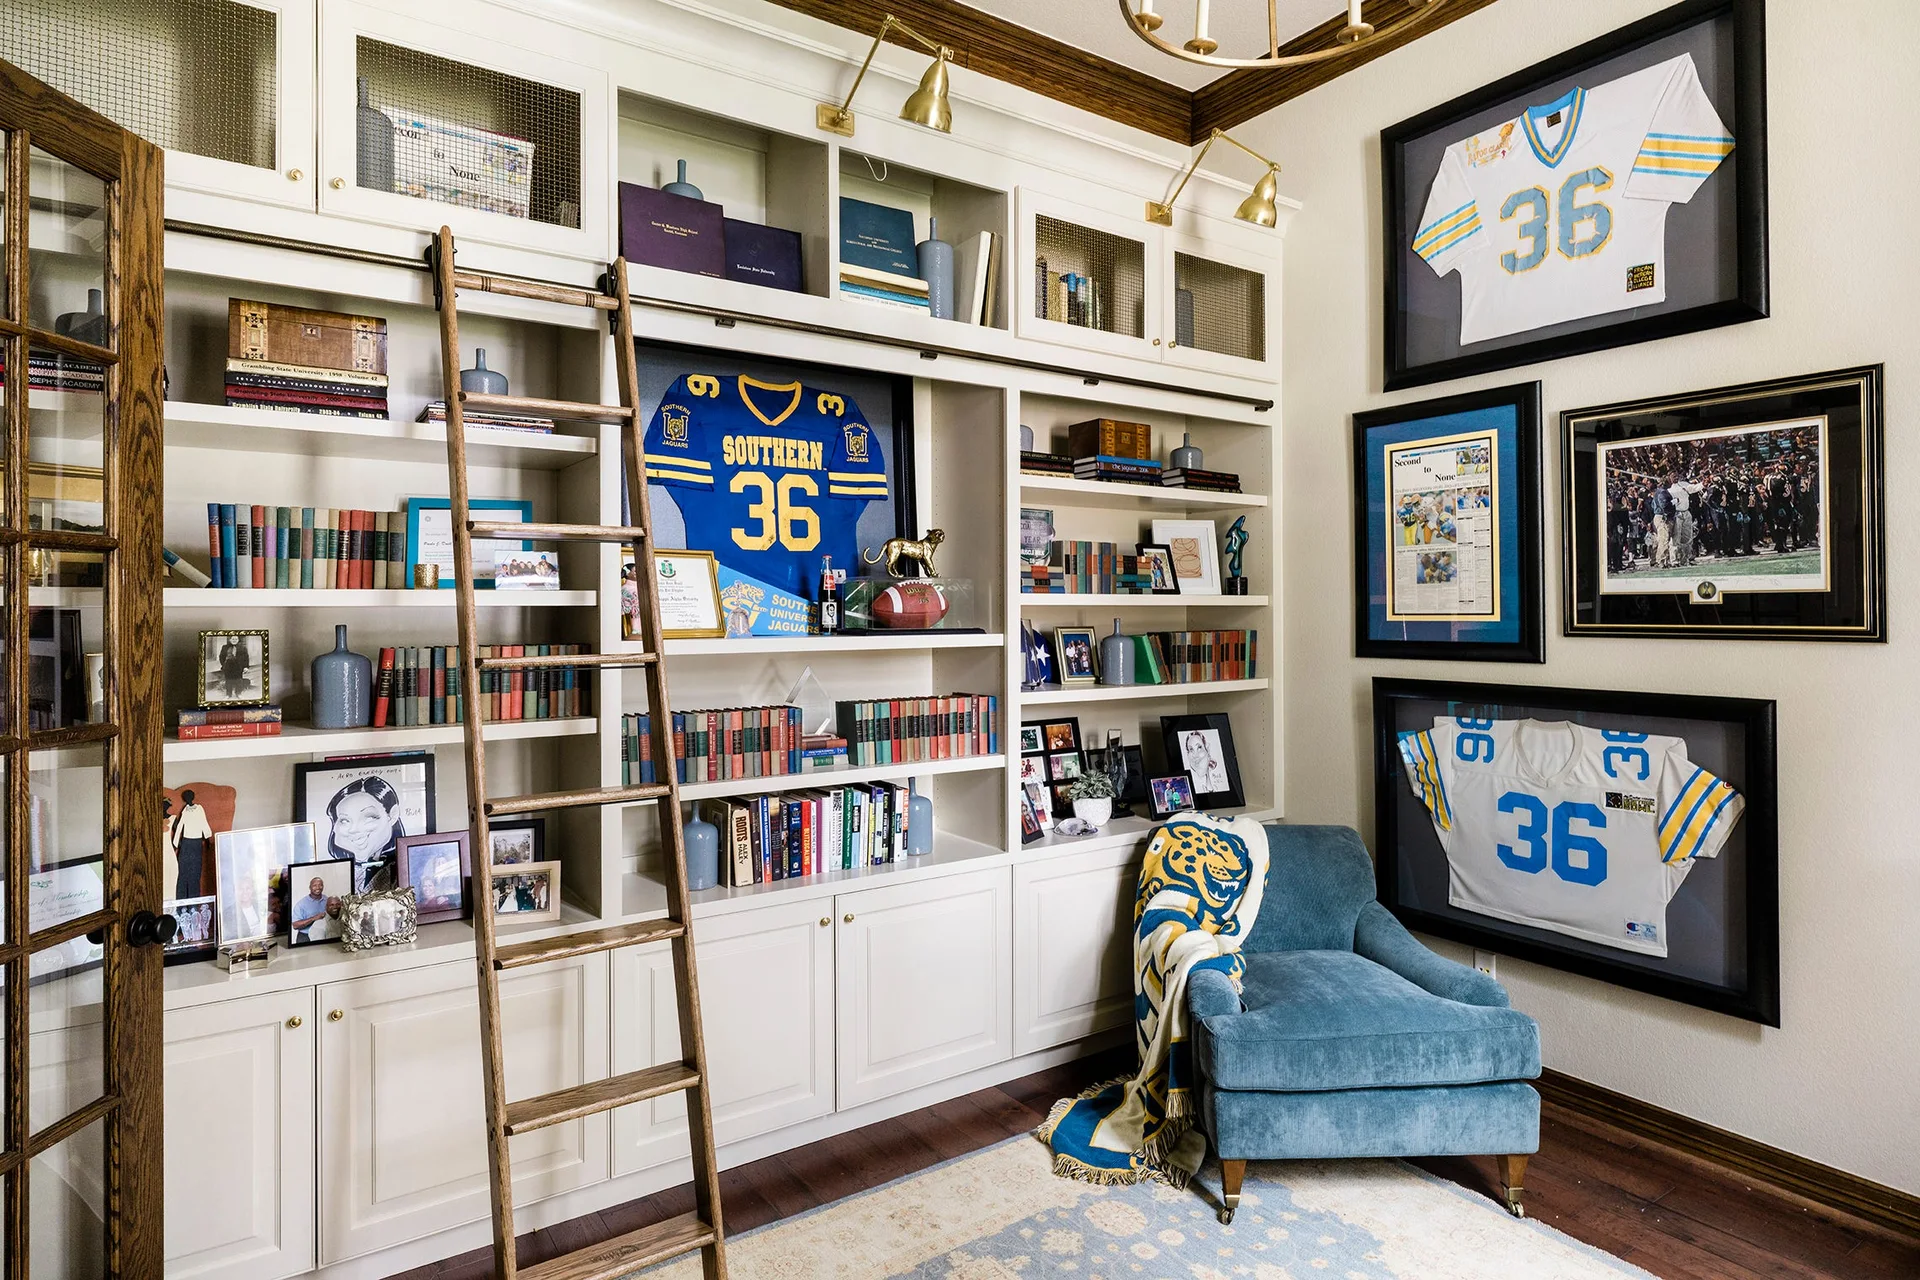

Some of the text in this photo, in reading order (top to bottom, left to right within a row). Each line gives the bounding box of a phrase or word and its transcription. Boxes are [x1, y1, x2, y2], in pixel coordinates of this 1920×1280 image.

[394, 126, 428, 140] econ
[433, 149, 444, 160] to
[450, 166, 481, 182] None
[1500, 164, 1614, 276] 36
[28, 368, 96, 380] OSEPH'S ACADEMY
[63, 363, 102, 372] ACADEMY
[242, 362, 274, 372] Grambling
[294, 368, 324, 376] University
[28, 376, 60, 386] SEPH'S
[62, 380, 100, 389] ACADEMY
[234, 388, 268, 397] Grambling
[287, 392, 318, 401] University
[660, 403, 692, 416] SOUTHERN
[817, 392, 845, 417] 3
[842, 422, 870, 434] SOUTHERN
[662, 440, 688, 449] JAGUARS
[722, 435, 823, 470] SOUTHERN
[1394, 457, 1422, 467] Second
[1435, 474, 1456, 482] None
[730, 471, 821, 552] 36
[1024, 536, 1041, 544] YEAR
[772, 594, 818, 615] SOUTHE
[770, 608, 817, 624] UNIVERSI
[768, 620, 819, 634] JAGUARS
[736, 816, 748, 842] ROOTS
[1497, 791, 1608, 887] 36
